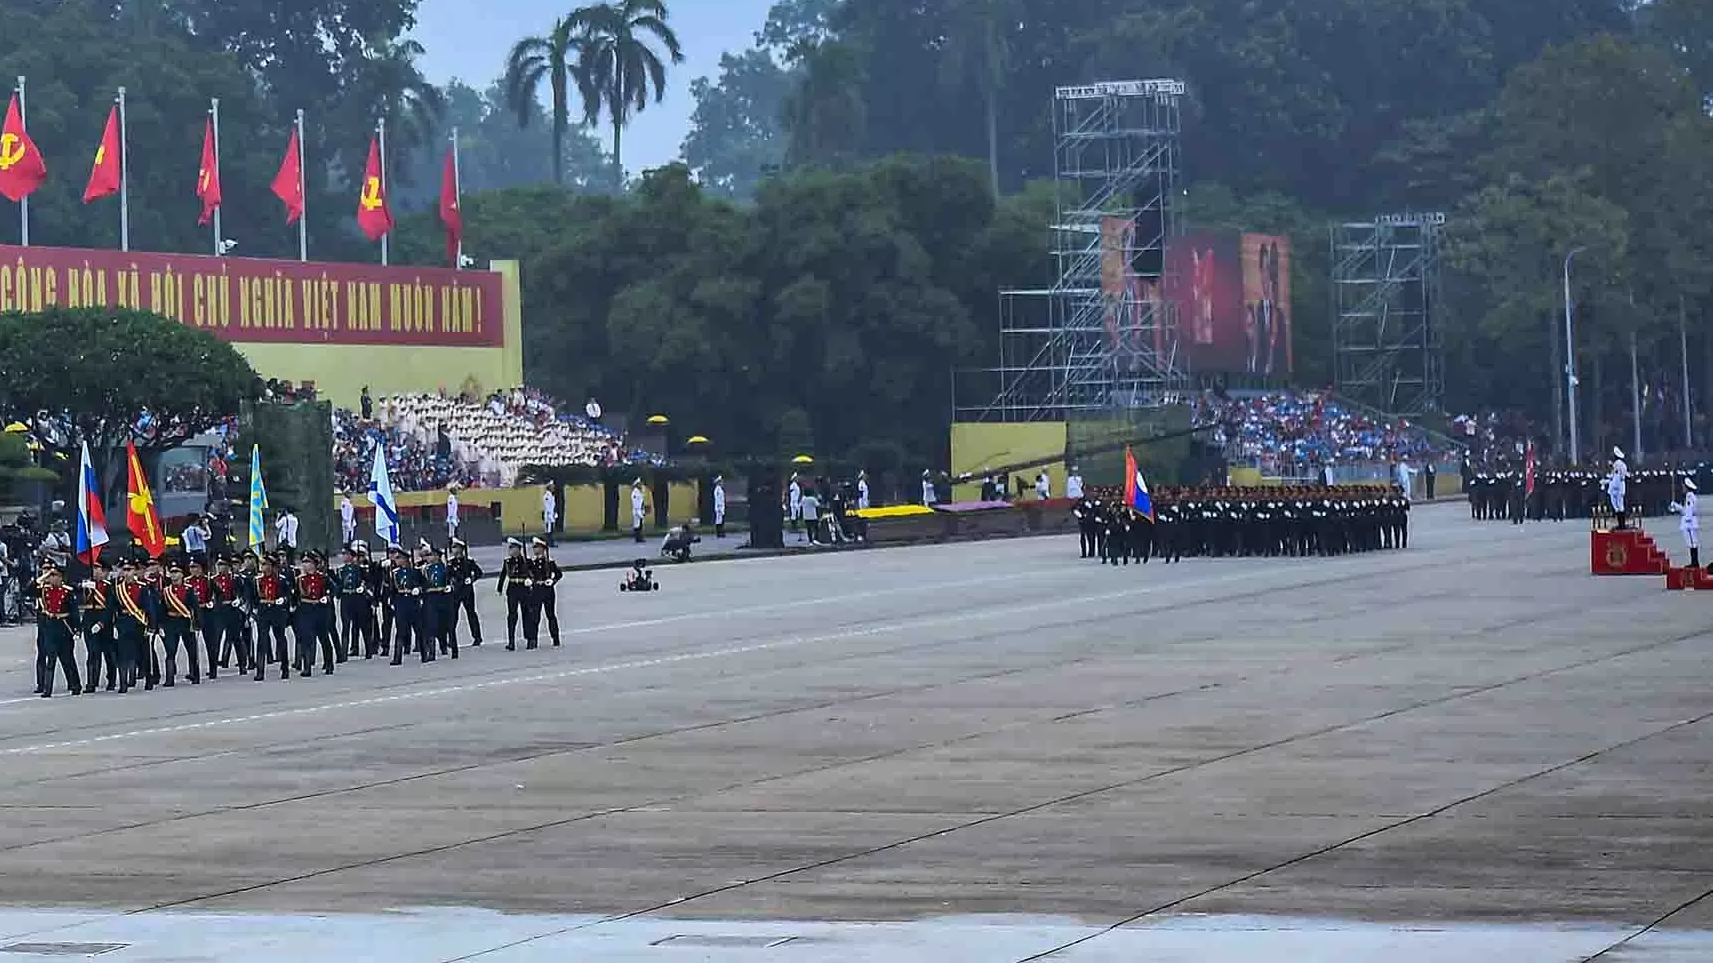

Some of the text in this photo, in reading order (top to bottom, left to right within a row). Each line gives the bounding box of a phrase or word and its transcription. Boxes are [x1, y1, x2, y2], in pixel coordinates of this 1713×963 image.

[193, 263, 230, 327] CHỦ
[239, 269, 294, 328] NGHĨA
[302, 271, 339, 340] VIỆT
[347, 281, 382, 330] NAM
[390, 276, 434, 332] MUÔN
